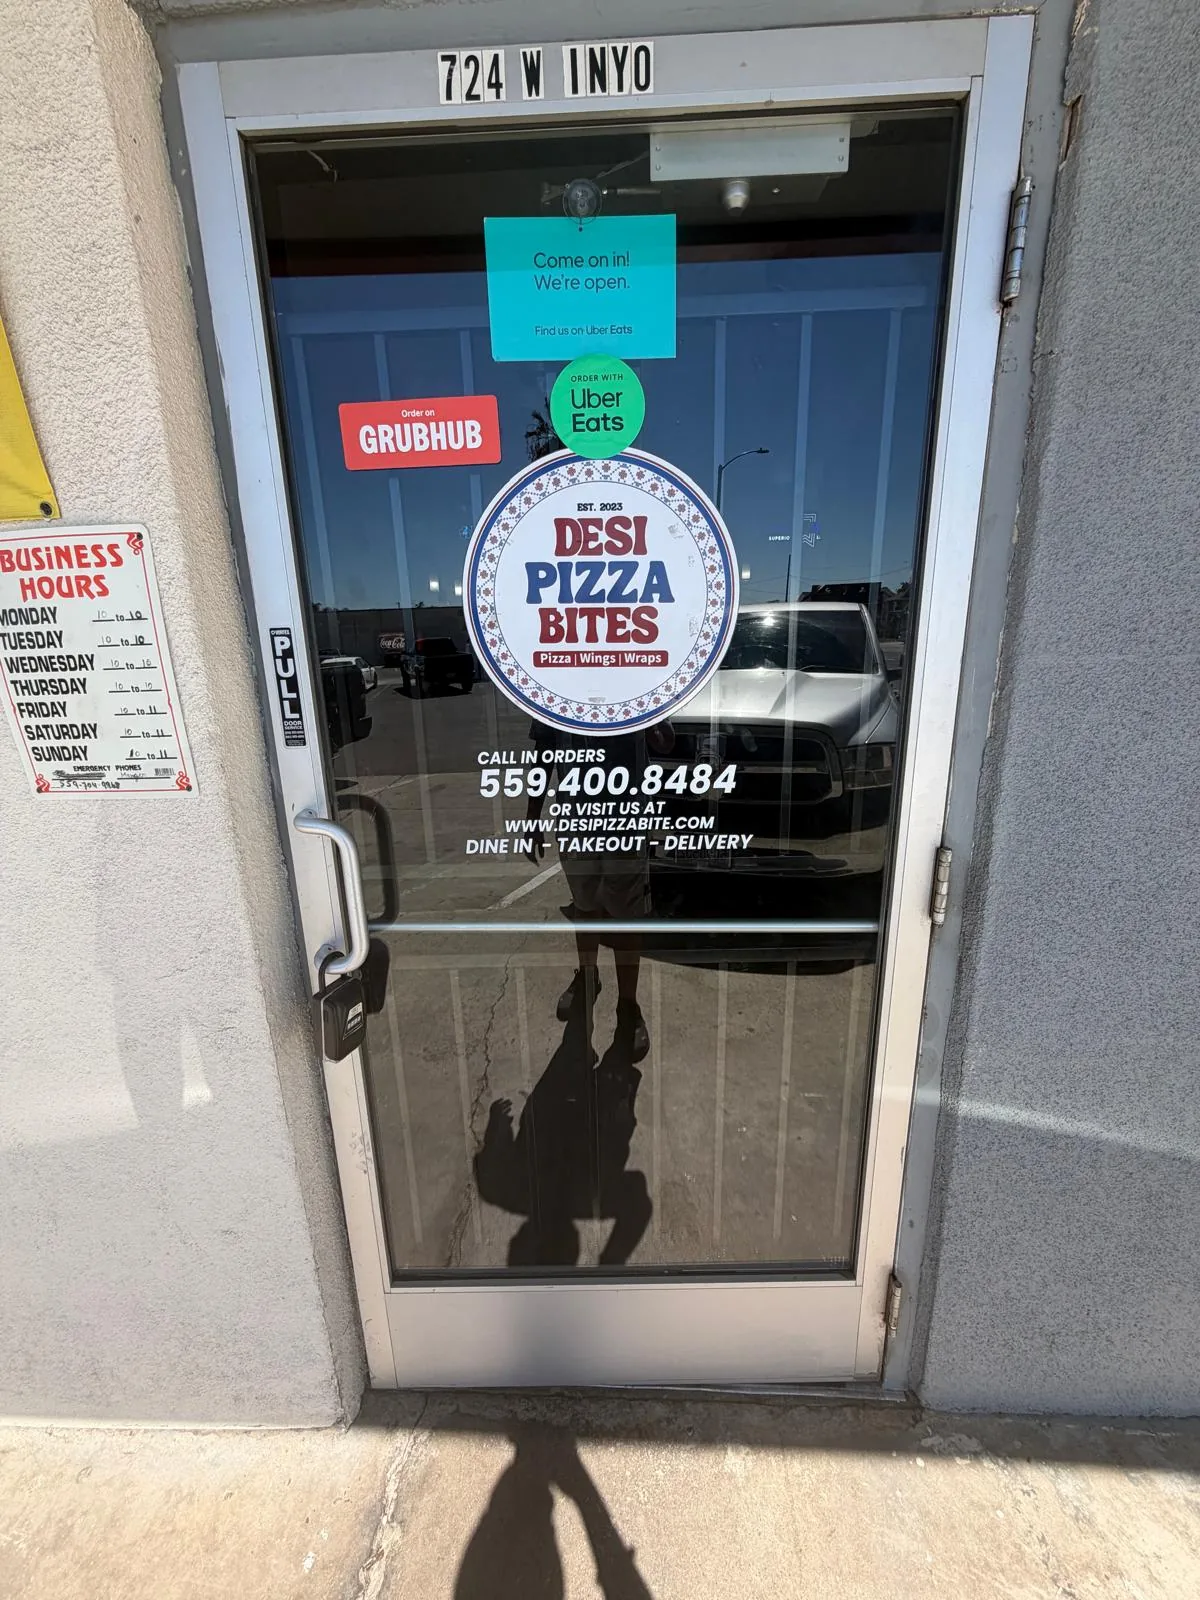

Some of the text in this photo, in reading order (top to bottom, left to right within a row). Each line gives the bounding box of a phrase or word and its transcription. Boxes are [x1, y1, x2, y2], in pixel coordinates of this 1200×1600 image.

[440, 44, 651, 101] 724 W INYO
[533, 250, 630, 268] Come on in!
[534, 274, 630, 293] We're open.
[535, 324, 633, 336] Find us on Uber Eats
[570, 373, 624, 383] ORDER WITH
[570, 388, 623, 409] Uber
[401, 409, 424, 418] Order
[572, 412, 624, 433] Eats
[359, 419, 483, 455] GRUBHUB
[577, 502, 623, 512] EST. 2023
[554, 515, 648, 557] DESI
[19, 574, 110, 603] HOURS
[524, 560, 675, 604] PIZZA
[0, 606, 57, 626] MONDAY
[115, 613, 125, 622] to
[129, 610, 142, 620] 10
[538, 605, 659, 644] BITES
[0, 630, 145, 650] TUESDAY 10 to 10
[4, 654, 95, 674] WEDNESDAY
[111, 659, 120, 668] 10
[125, 662, 135, 670] to
[540, 652, 662, 666] Pizza Wings Wraps
[10, 677, 87, 697] THURSDAY
[115, 682, 124, 690] 10
[131, 685, 140, 693] to
[274, 636, 300, 719] PULL
[16, 701, 68, 719] FRIDAY
[149, 705, 157, 714] 11
[24, 723, 98, 741] SATURDAY
[124, 728, 133, 736] 10
[31, 745, 88, 762] SUNDAY
[159, 749, 168, 758] 11
[477, 749, 606, 765] CALL IN ORDERS
[479, 764, 737, 798] 559.400.8484
[549, 801, 666, 816] OR VISIT US AT
[505, 816, 715, 833] WWW.DESIPIZZABITE.COM
[466, 838, 511, 854] DINE
[513, 838, 533, 853] IN
[557, 836, 646, 853] TAKEOUT
[664, 834, 754, 851] DELIVERY
